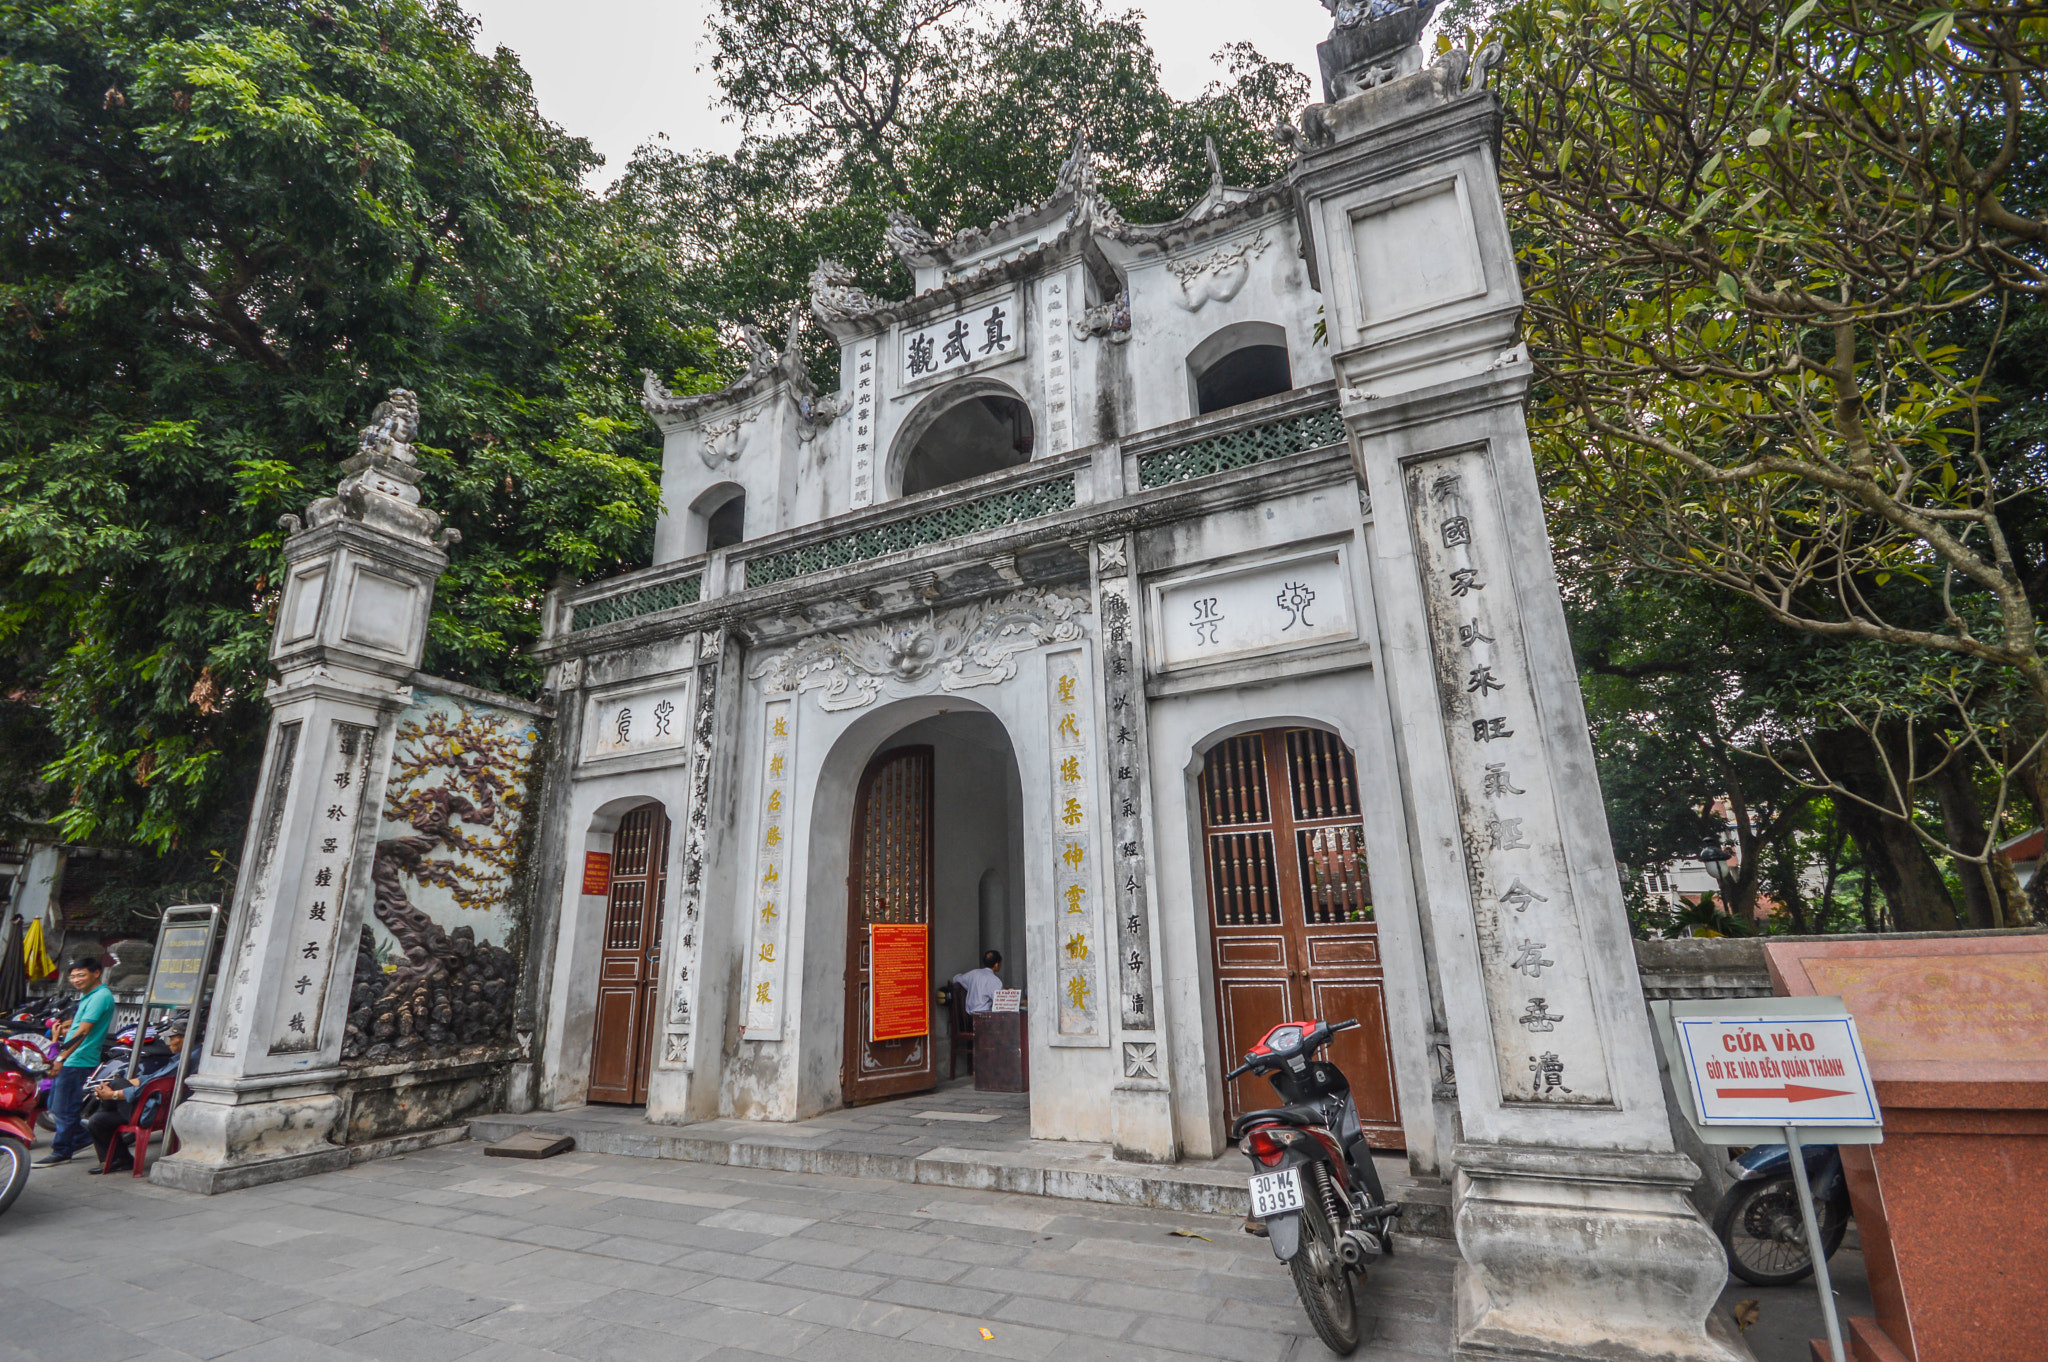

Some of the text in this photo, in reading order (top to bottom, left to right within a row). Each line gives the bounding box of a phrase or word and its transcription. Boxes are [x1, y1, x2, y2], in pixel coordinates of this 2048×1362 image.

[1722, 1027, 1815, 1052] CỬA VÀO
[1724, 1061, 1738, 1079] XE
[1738, 1057, 1759, 1079] VÀO
[1259, 1189, 1296, 1212] 8395
